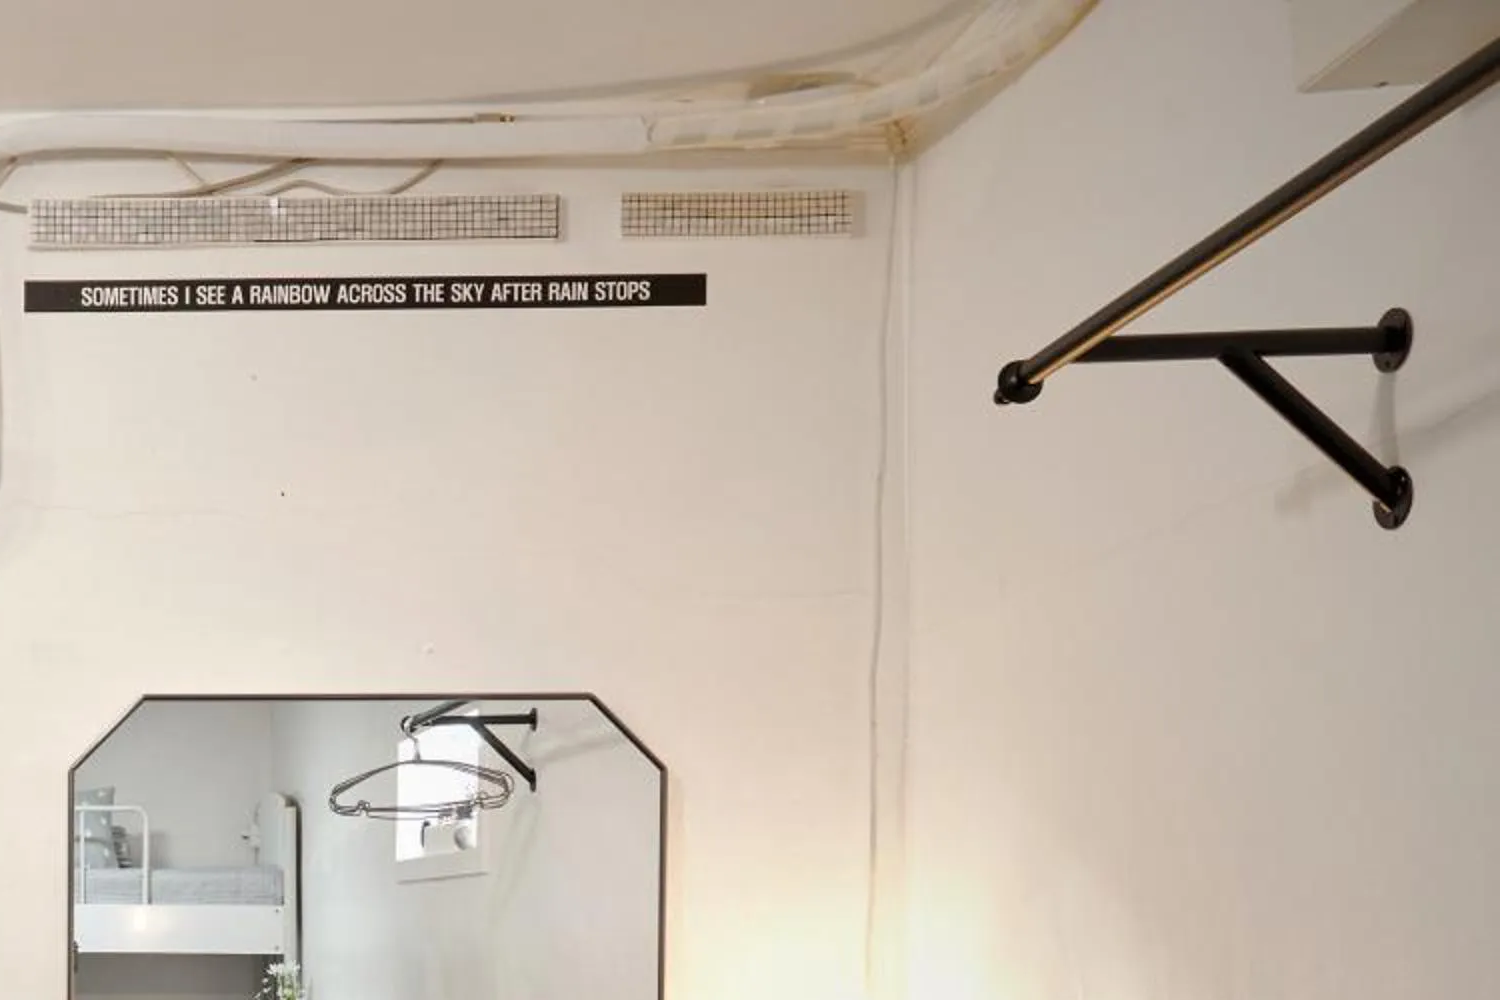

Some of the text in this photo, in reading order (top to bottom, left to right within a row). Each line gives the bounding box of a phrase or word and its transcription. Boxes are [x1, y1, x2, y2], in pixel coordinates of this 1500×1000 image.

[80, 281, 651, 307] SOMETIMES I SEE A RAINBOW ACROSS THE SKY AFTER RAIN STOPS
